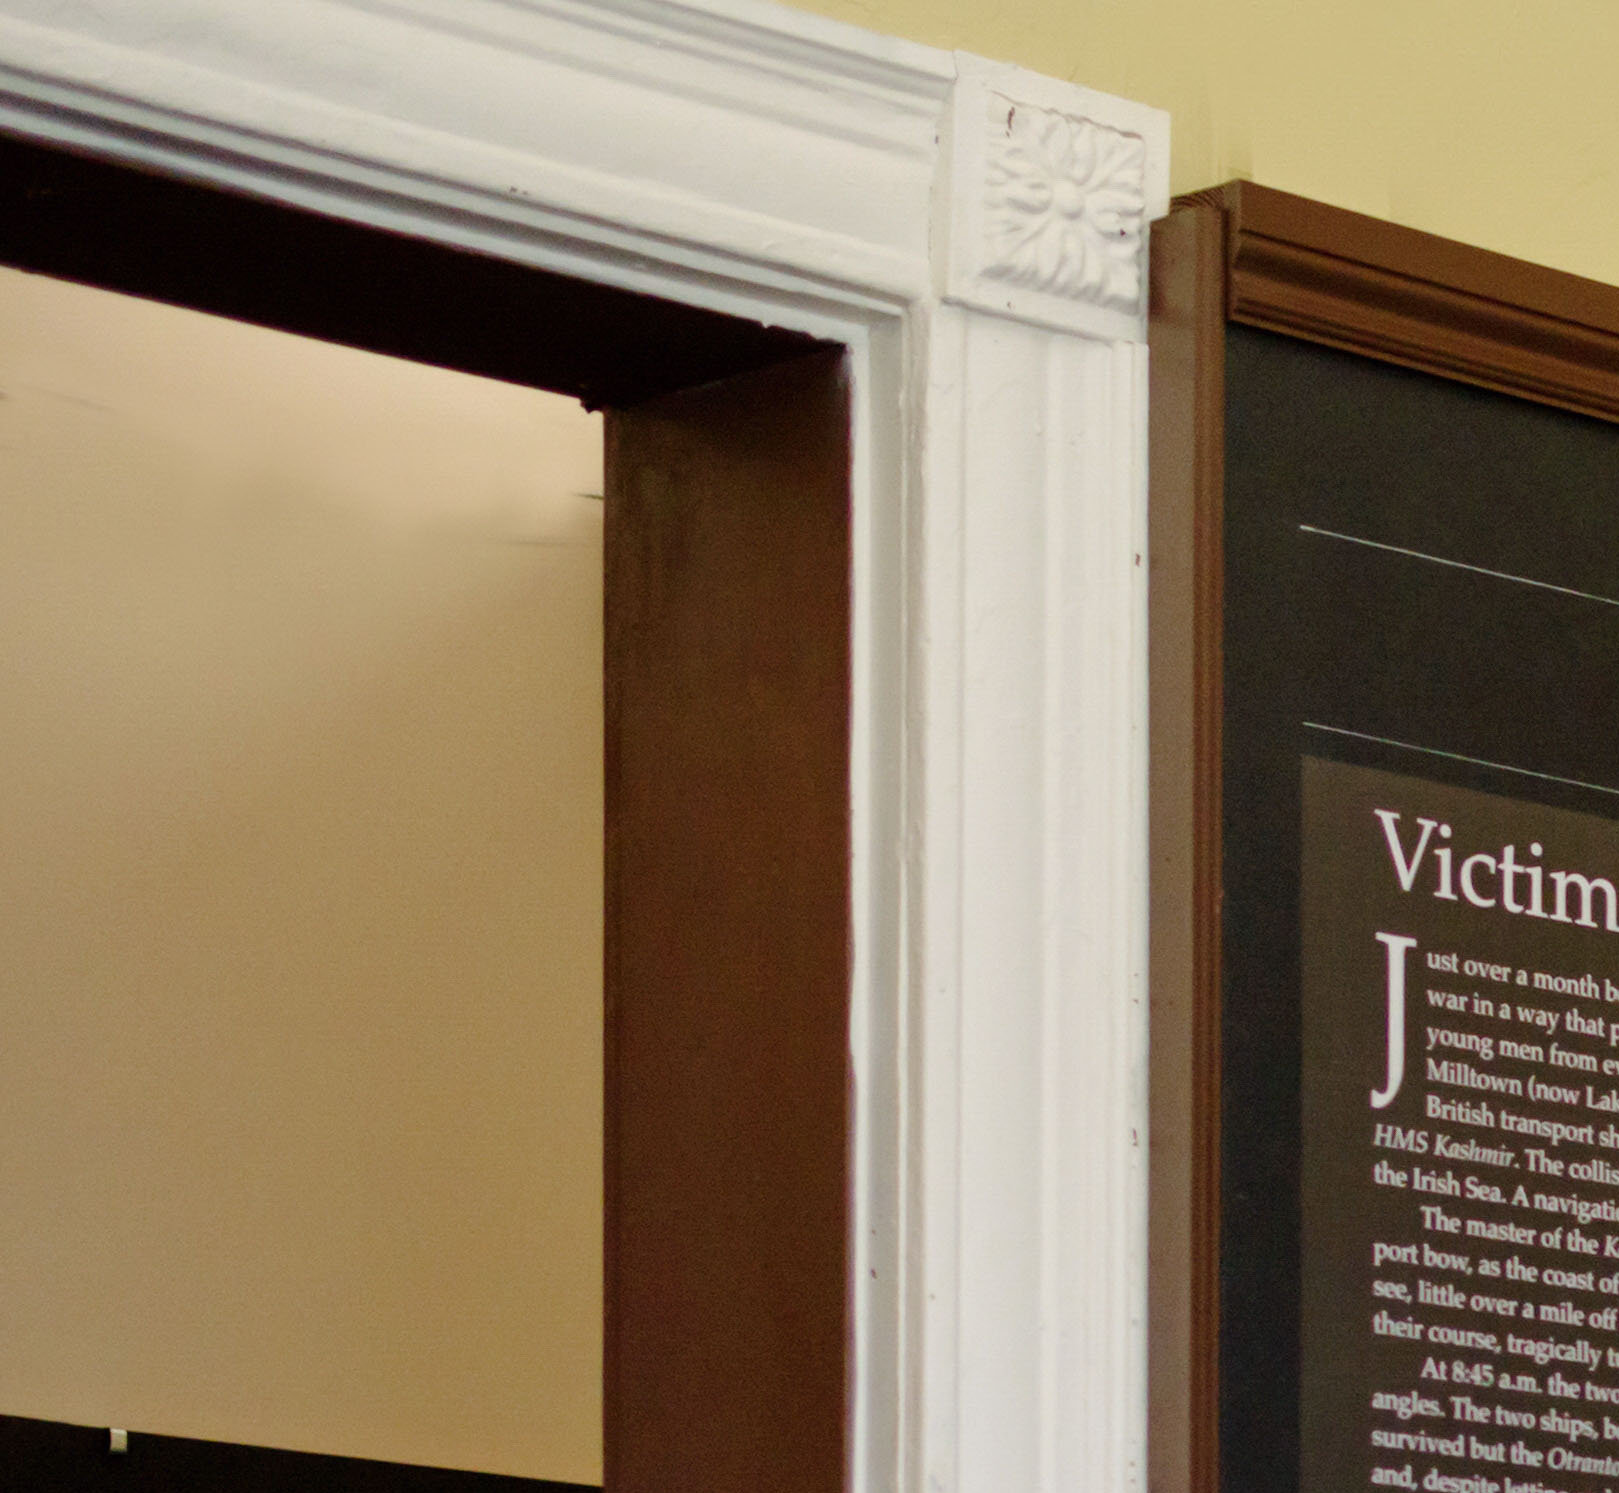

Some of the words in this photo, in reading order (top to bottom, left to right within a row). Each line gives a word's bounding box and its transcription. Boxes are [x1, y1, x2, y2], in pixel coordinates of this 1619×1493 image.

[1462, 958, 1512, 983] over
[1513, 967, 1529, 987] a
[1531, 970, 1601, 1001] month
